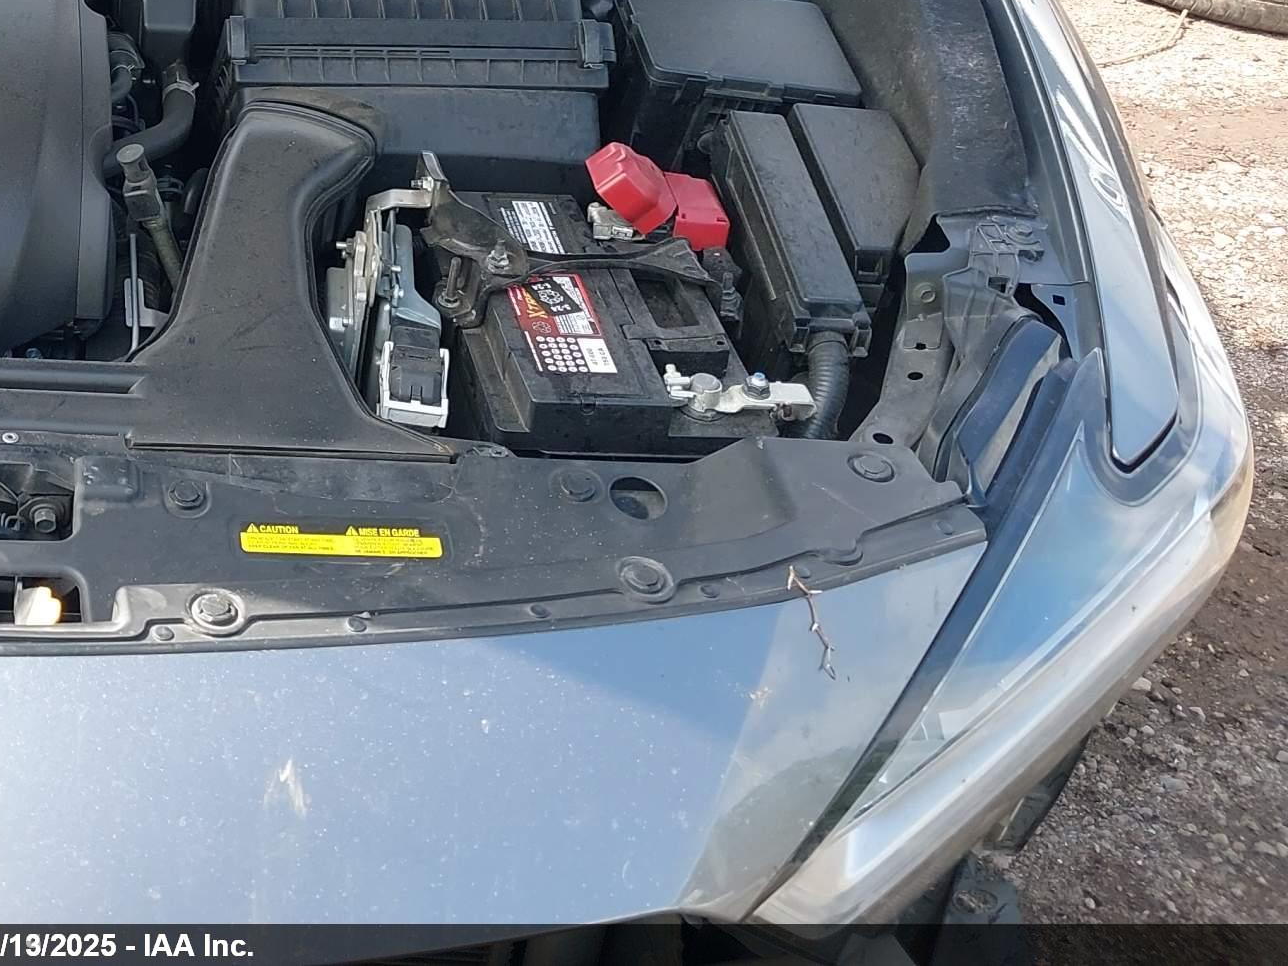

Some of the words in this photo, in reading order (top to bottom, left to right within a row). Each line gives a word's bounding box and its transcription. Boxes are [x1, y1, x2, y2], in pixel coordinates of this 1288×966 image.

[259, 524, 299, 534] CAUTION
[358, 527, 379, 536] MISE
[379, 528, 392, 537] EN
[392, 528, 420, 538] GARDE
